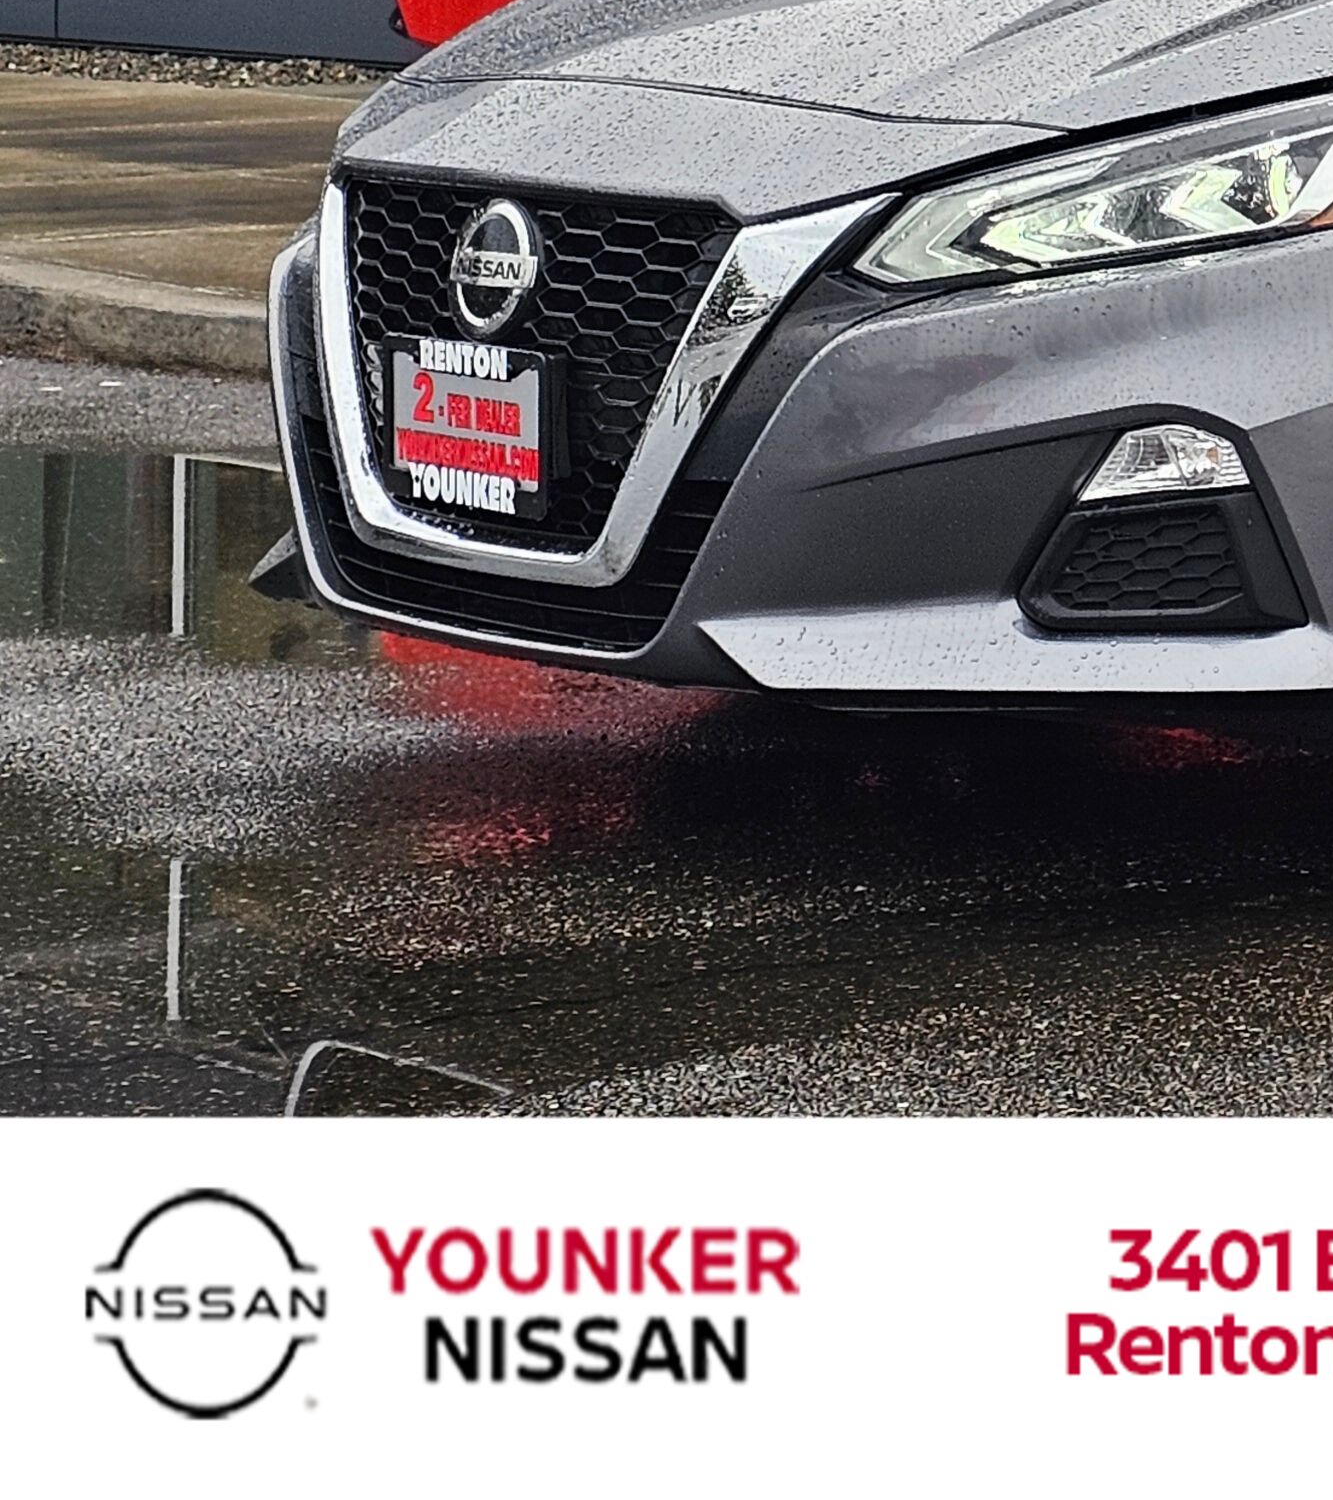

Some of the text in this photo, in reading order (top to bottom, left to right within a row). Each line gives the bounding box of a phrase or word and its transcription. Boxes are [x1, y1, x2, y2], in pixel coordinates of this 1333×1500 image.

[419, 339, 508, 381] RENTON
[412, 371, 435, 423] 2
[408, 461, 516, 515] YOUNKER
